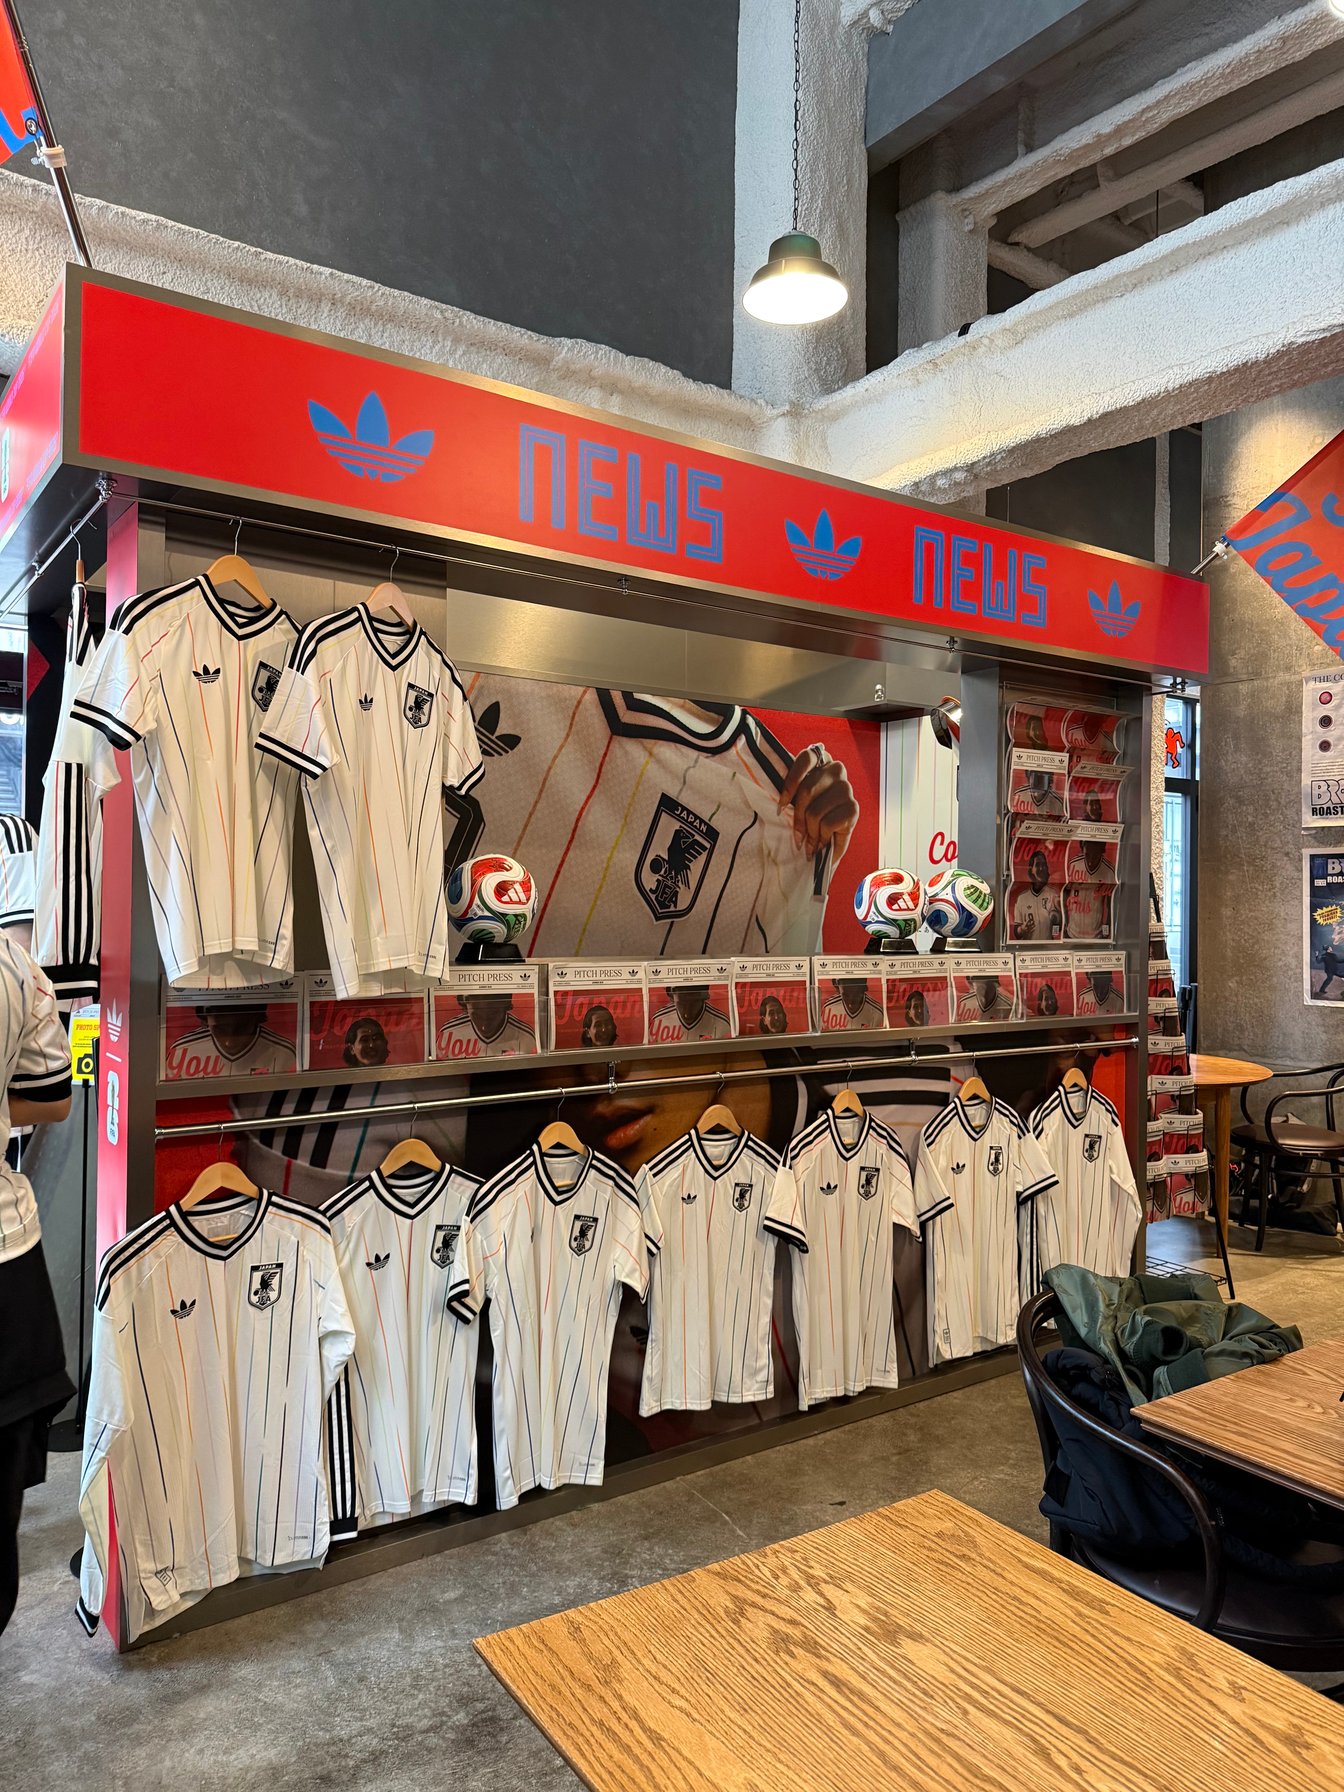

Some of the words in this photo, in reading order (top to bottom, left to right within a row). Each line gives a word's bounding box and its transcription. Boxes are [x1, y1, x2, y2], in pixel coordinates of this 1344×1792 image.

[519, 423, 723, 565] NEWS
[913, 525, 1046, 628] NEWS
[1312, 674, 1333, 684] THE
[674, 806, 708, 834] JAPAN
[667, 967, 688, 976] PITCH
[690, 966, 711, 975] PRESS
[752, 964, 771, 972] PITCH
[772, 963, 791, 971] PRESS
[832, 961, 849, 969] PITCH
[850, 960, 868, 968] PRESS
[458, 973, 485, 982] PITCH
[487, 972, 514, 982] PRESS
[574, 970, 597, 978] PITCH
[600, 969, 623, 978] PRESS
[555, 990, 643, 1025] Jaan
[76, 1023, 94, 1031] PHOTO
[649, 1020, 684, 1043] You
[436, 1031, 481, 1060] You
[167, 1048, 225, 1079] You
